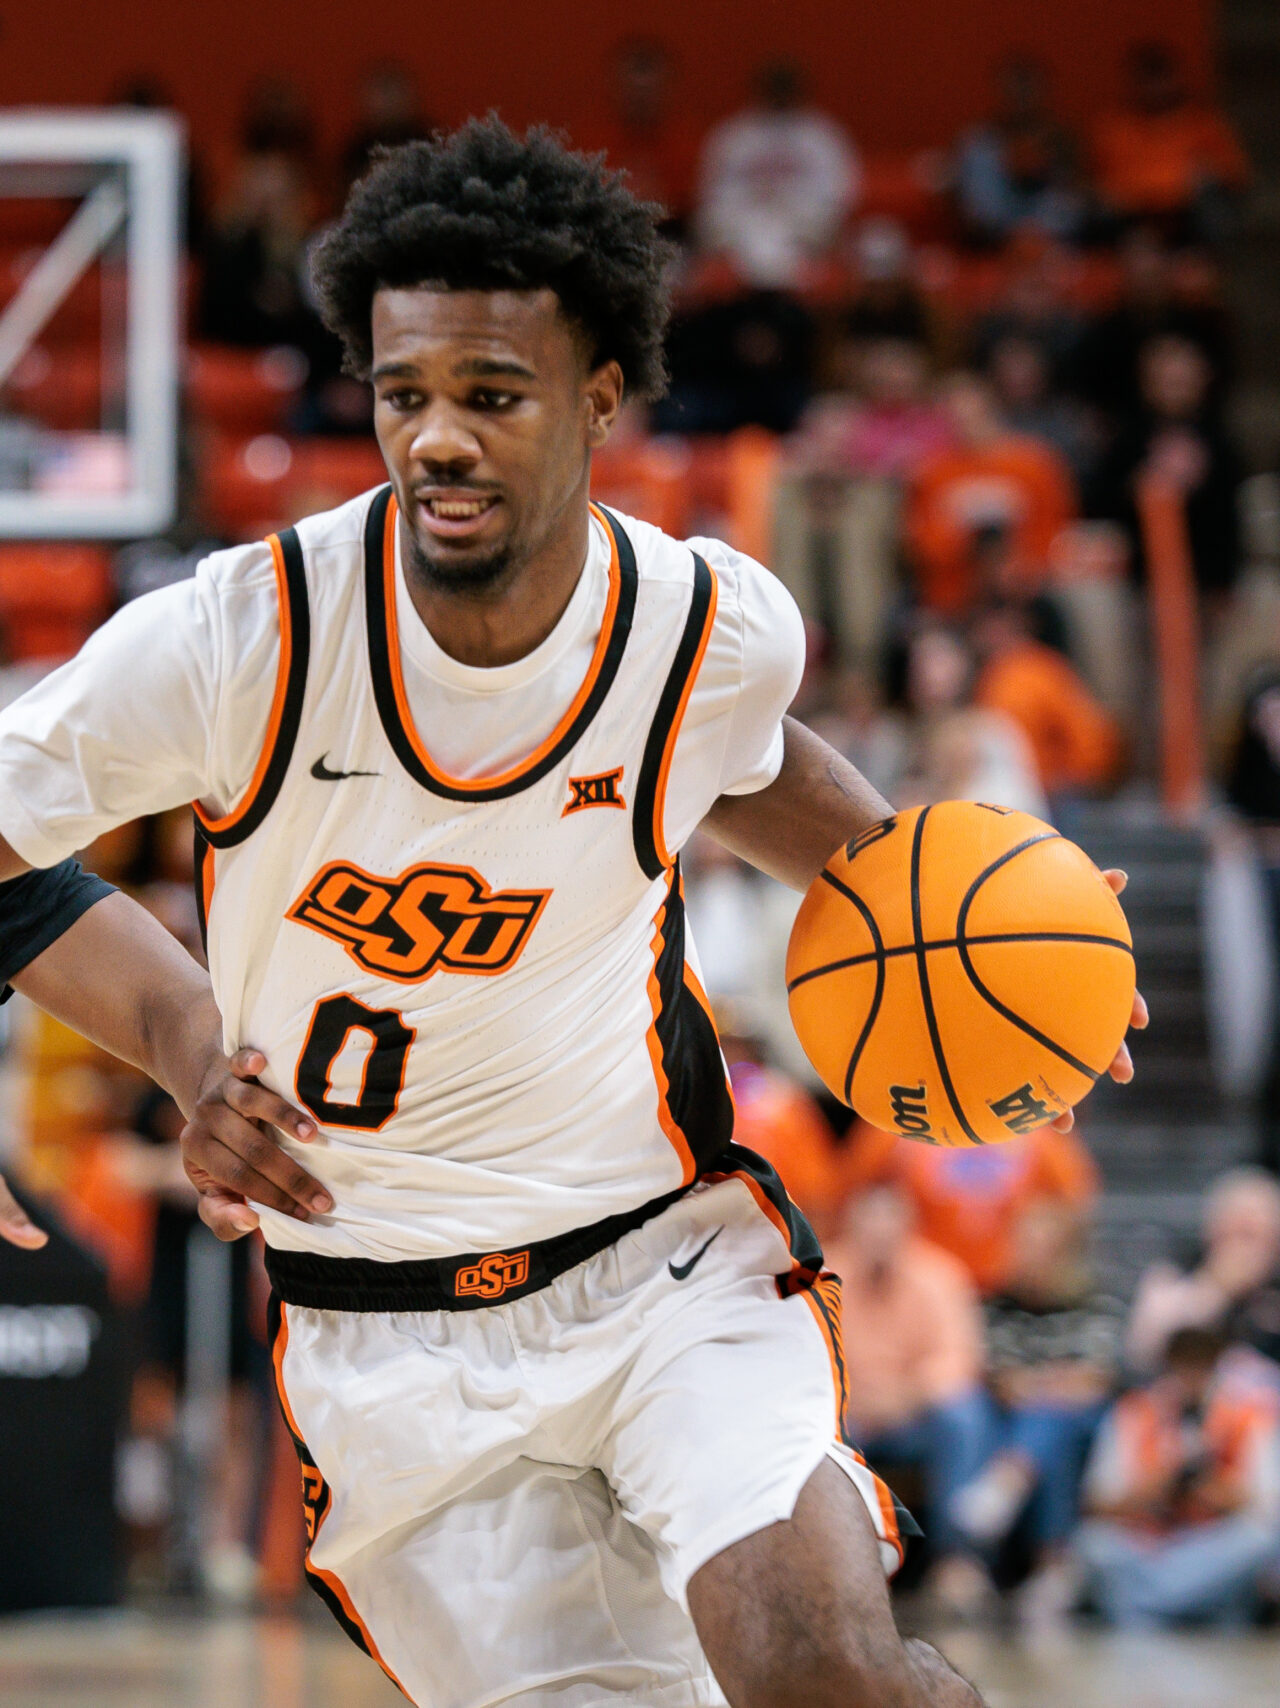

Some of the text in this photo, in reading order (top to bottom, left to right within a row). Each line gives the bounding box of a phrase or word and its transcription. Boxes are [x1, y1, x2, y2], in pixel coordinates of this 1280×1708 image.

[565, 769, 623, 813] XII
[285, 859, 553, 984] OSU
[294, 992, 417, 1132] 0
[455, 1250, 530, 1298] OSU
